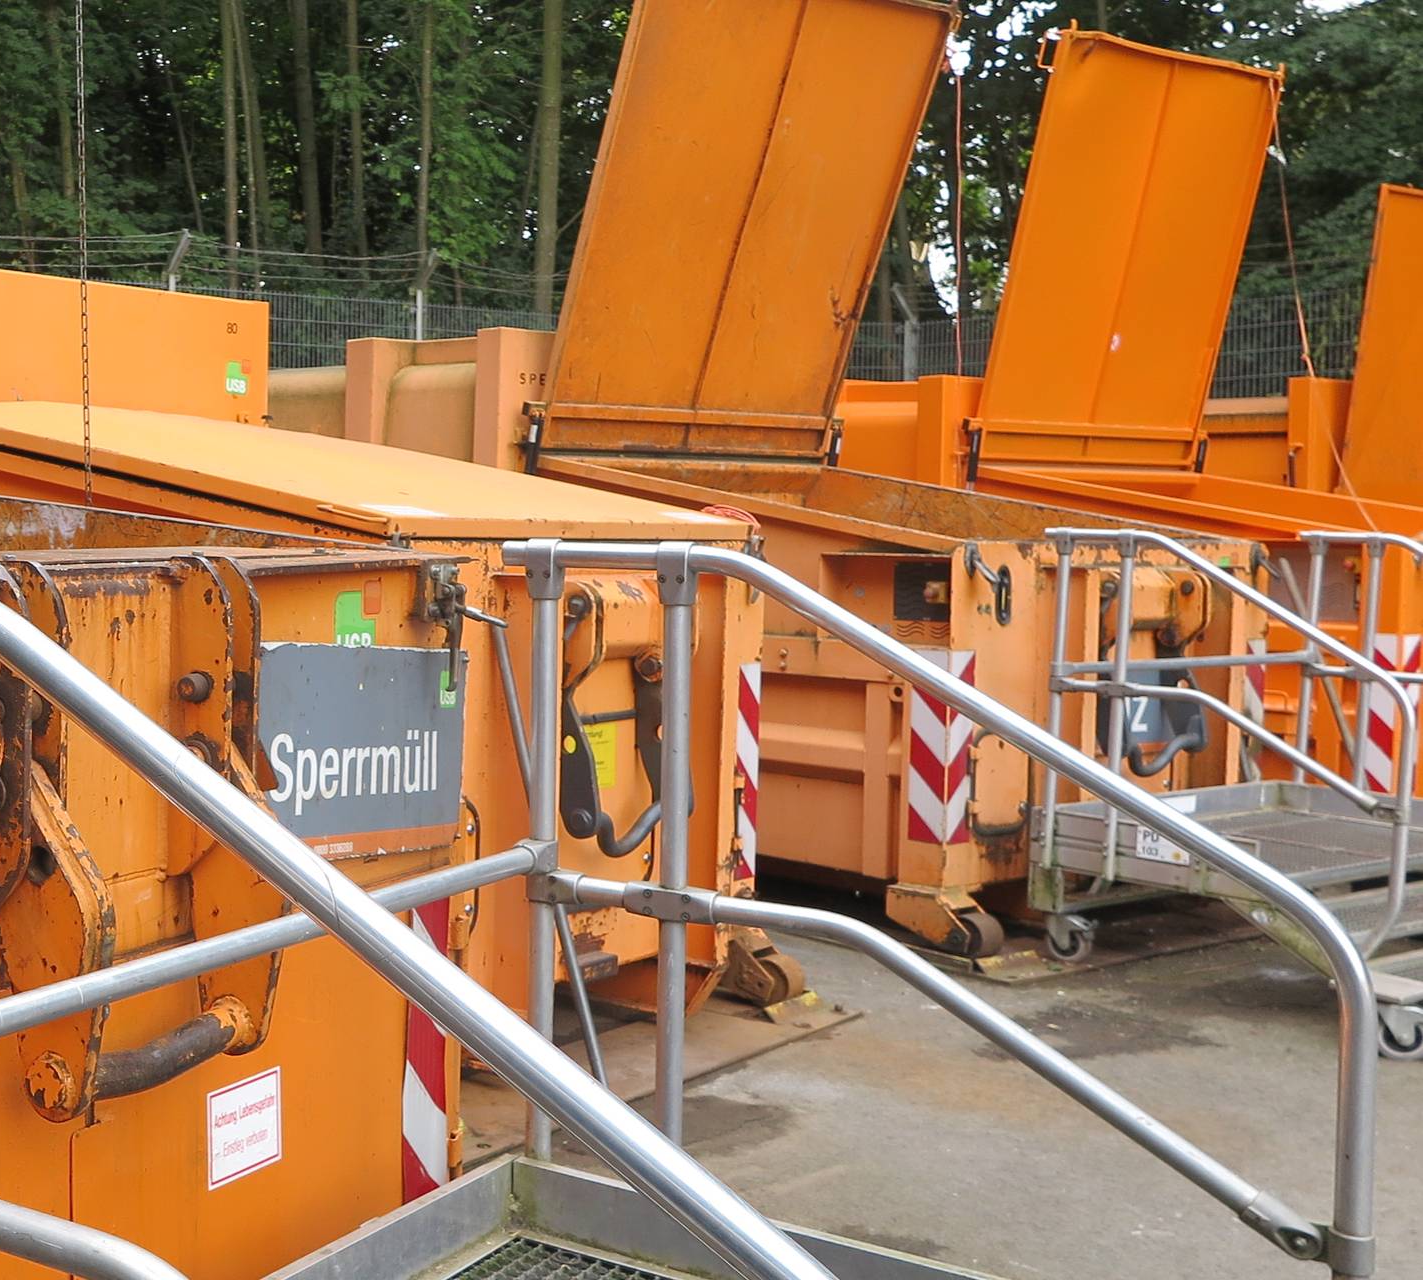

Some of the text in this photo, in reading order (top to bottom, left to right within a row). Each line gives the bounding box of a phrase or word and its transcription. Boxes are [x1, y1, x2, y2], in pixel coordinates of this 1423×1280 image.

[226, 322, 238, 334] 80
[225, 377, 247, 394] USB
[269, 729, 438, 816] Sperrmüll
[214, 1094, 275, 1128] Achtung Lebensgefahr
[223, 1139, 245, 1157] Einstieg
